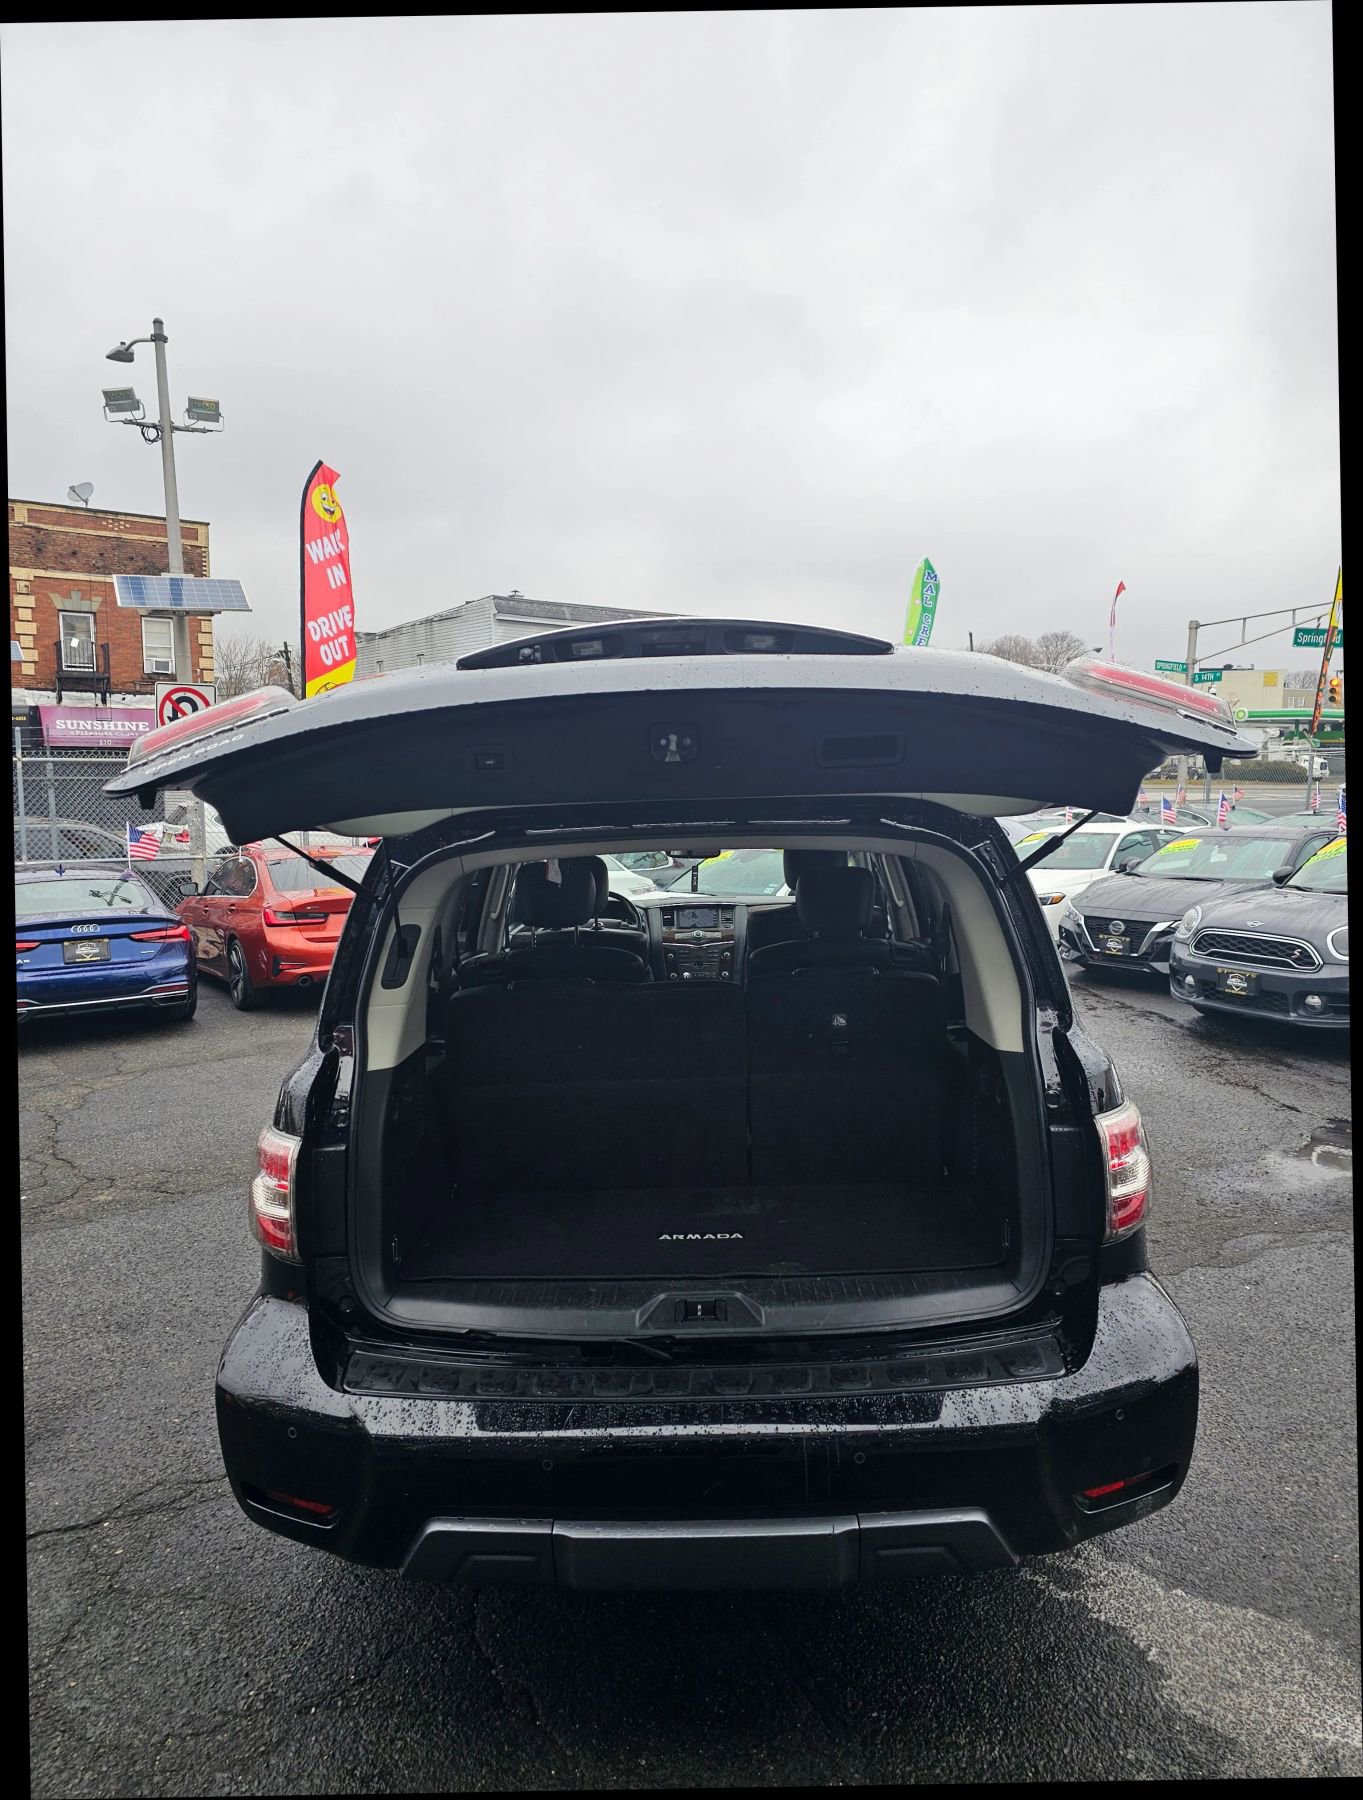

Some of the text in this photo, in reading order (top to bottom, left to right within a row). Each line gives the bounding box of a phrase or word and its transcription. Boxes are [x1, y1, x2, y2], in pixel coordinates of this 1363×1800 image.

[326, 563, 347, 589] IN
[924, 570, 939, 607] MAL
[307, 605, 353, 642] DRIVE
[320, 635, 350, 666] OUT
[1156, 661, 1183, 671] SPRINGFIELD
[1201, 673, 1214, 681] 14TH
[55, 719, 149, 732] SUNSHINE
[658, 1232, 744, 1240] ARMADA
